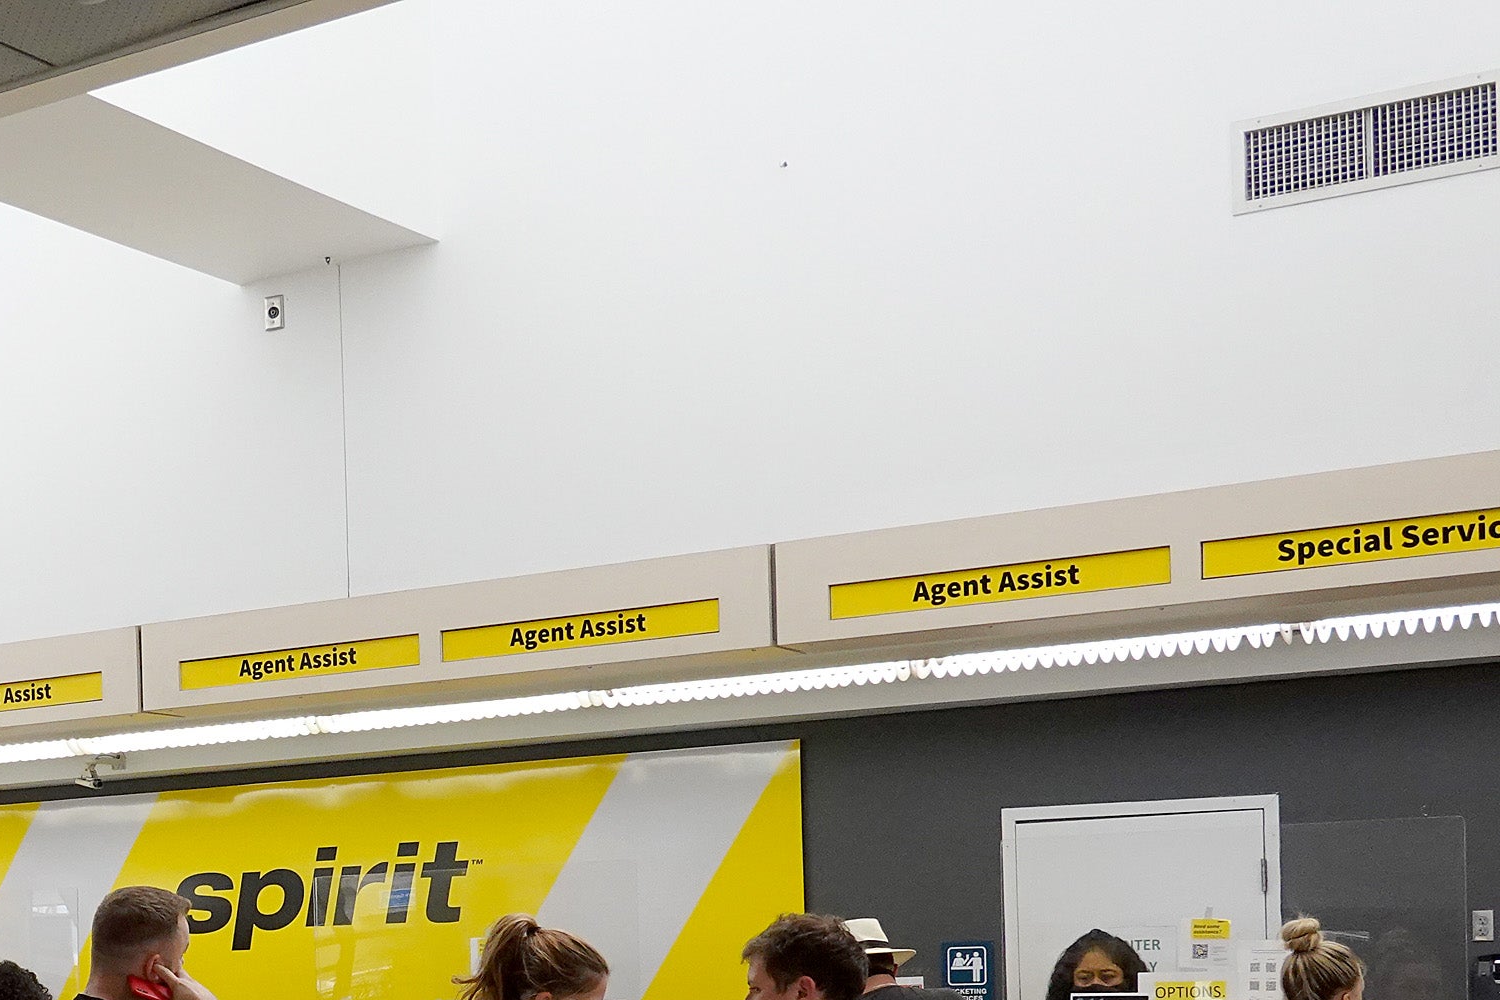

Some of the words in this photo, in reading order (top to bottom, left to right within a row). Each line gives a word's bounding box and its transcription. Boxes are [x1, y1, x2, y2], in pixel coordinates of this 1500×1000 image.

[1277, 528, 1393, 565] Special
[912, 573, 992, 605] Agent
[998, 564, 1080, 593] Assist
[509, 623, 575, 650] Agent
[579, 613, 647, 638] Assist
[238, 655, 295, 680] Agent
[299, 646, 357, 670] Assist
[3, 683, 52, 704] Assist
[174, 841, 468, 951] spirit
[1155, 985, 1226, 999] OPTIONS.
